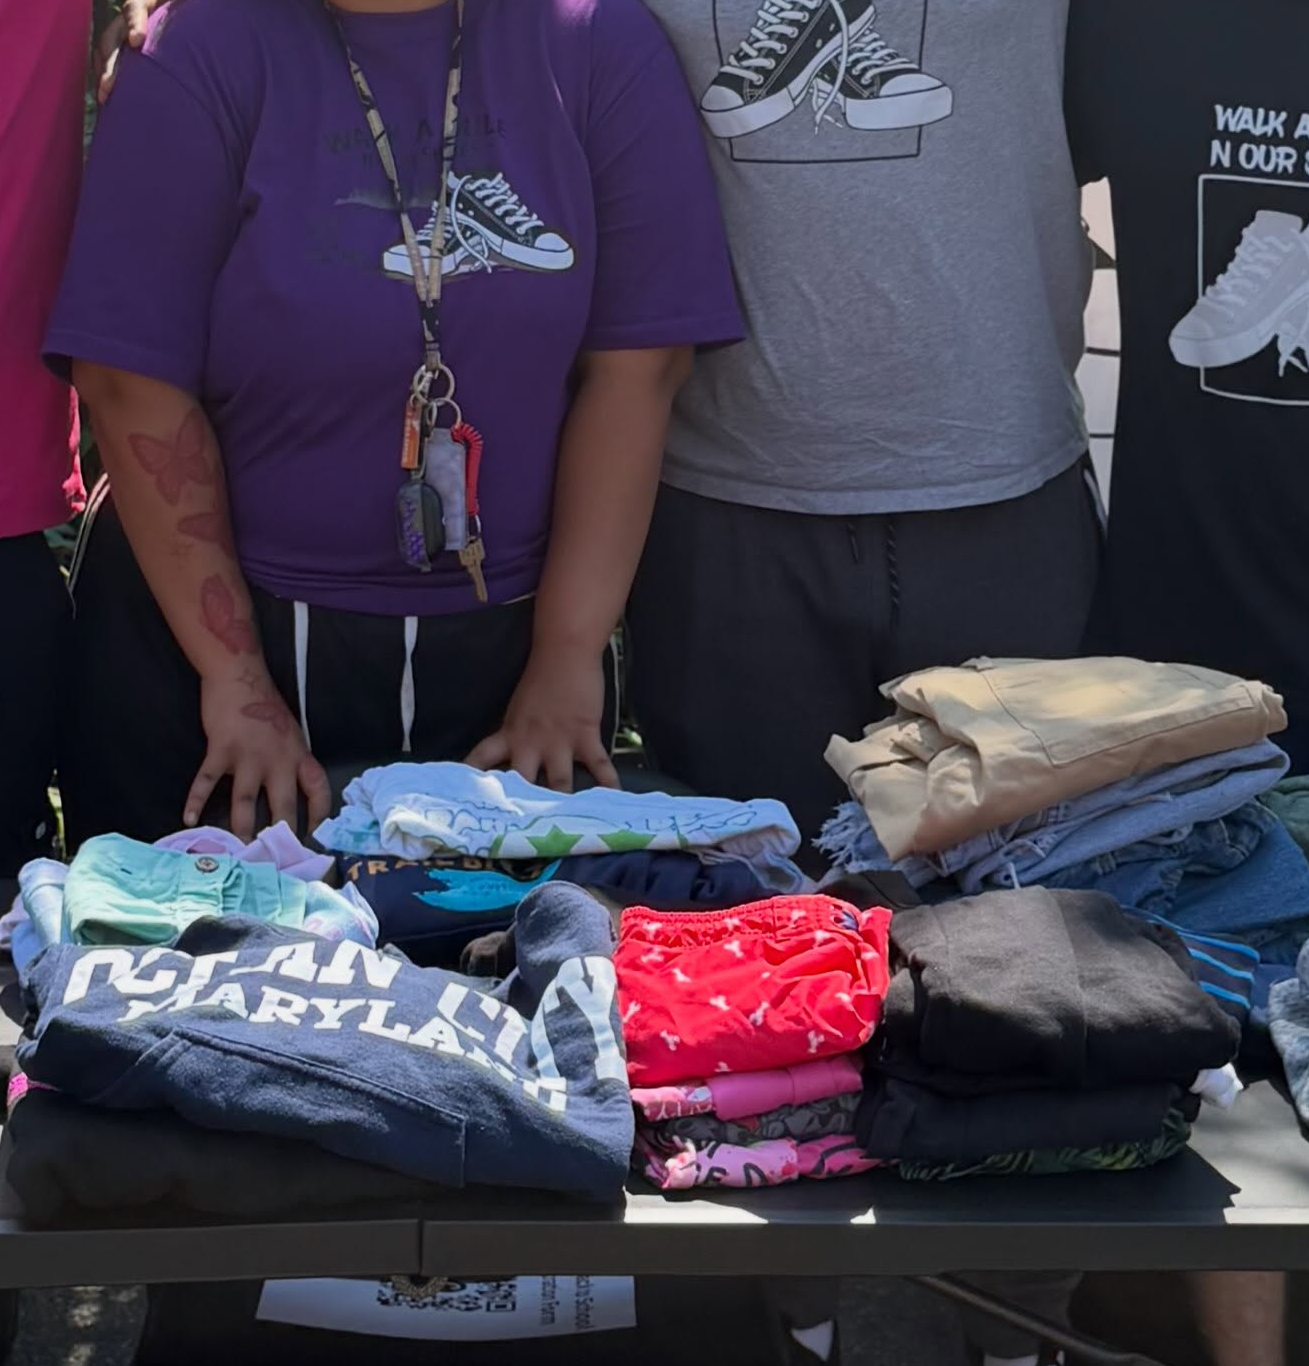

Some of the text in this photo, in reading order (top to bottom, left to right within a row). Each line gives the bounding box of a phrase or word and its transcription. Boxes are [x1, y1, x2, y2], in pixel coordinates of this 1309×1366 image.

[1214, 104, 1288, 138] WALK
[1209, 139, 1231, 169] N
[1239, 142, 1297, 174] OUR
